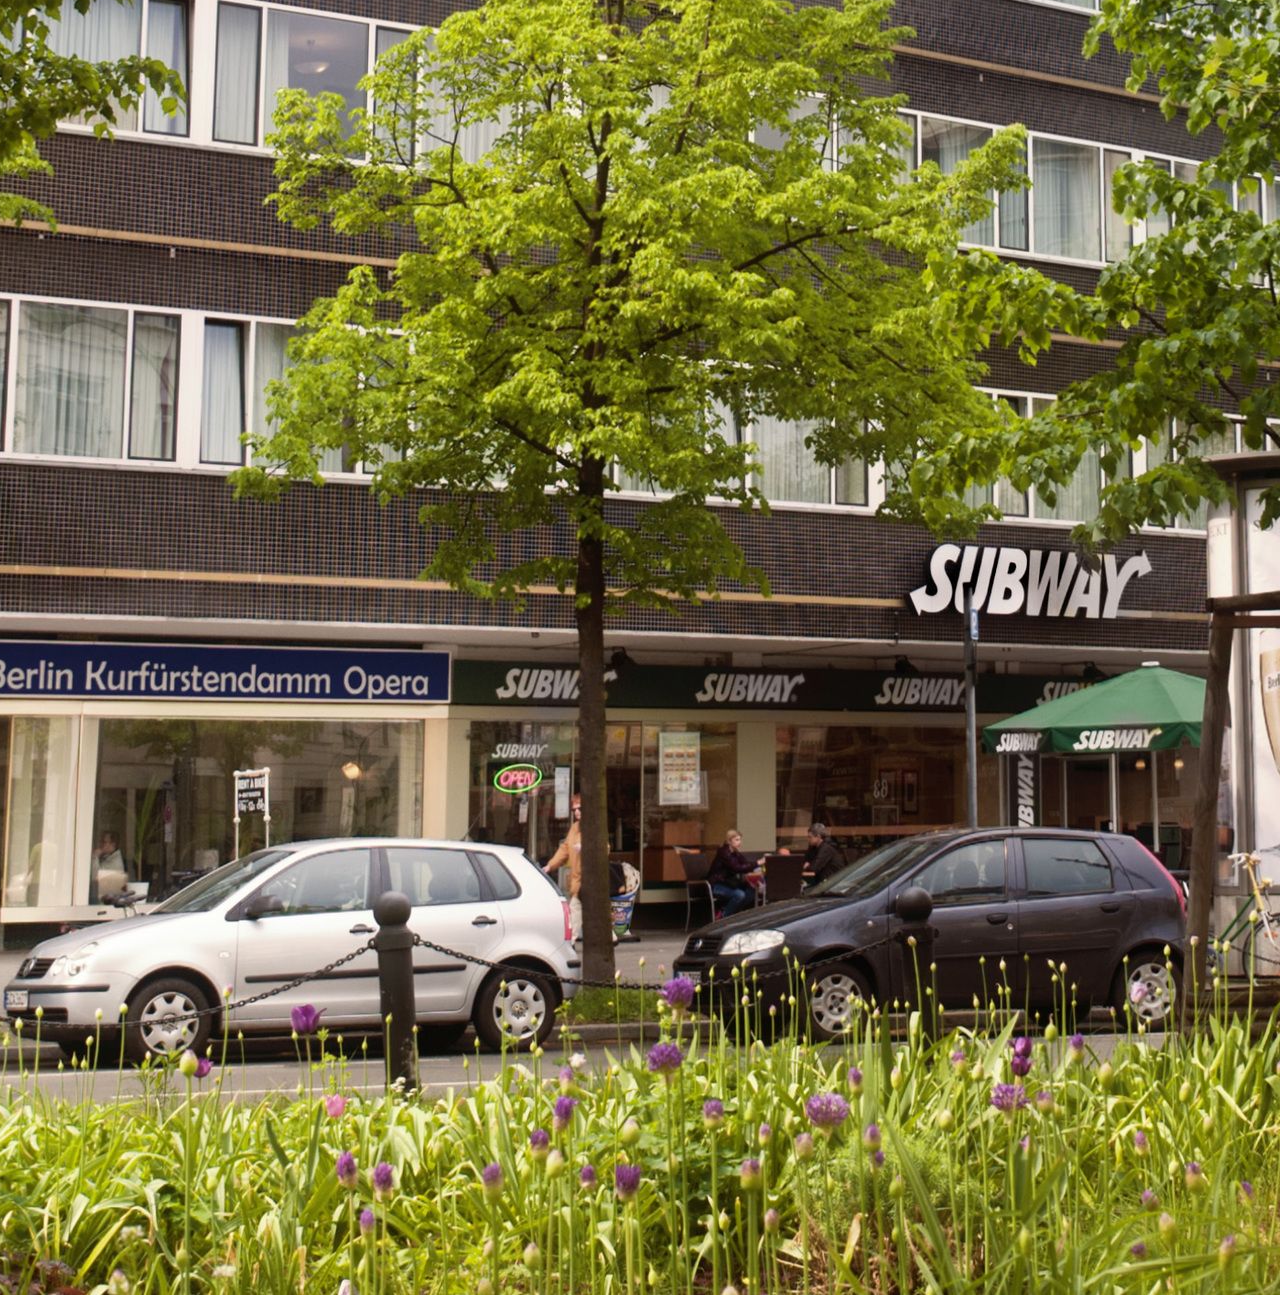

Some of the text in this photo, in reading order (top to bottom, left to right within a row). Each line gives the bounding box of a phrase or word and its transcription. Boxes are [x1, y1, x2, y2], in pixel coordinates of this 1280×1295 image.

[909, 543, 1152, 620] SUBWAY
[85, 660, 331, 695] Kurfürstendamm
[343, 665, 429, 700] Opera
[496, 668, 618, 700] SUBW
[695, 672, 805, 703] SUBWAY
[875, 677, 966, 706] SUBWAY
[491, 743, 549, 759] SUBWAY
[995, 731, 1043, 753] SUBWAY
[1073, 727, 1162, 751] SUBWAY
[500, 769, 537, 787] OPEN
